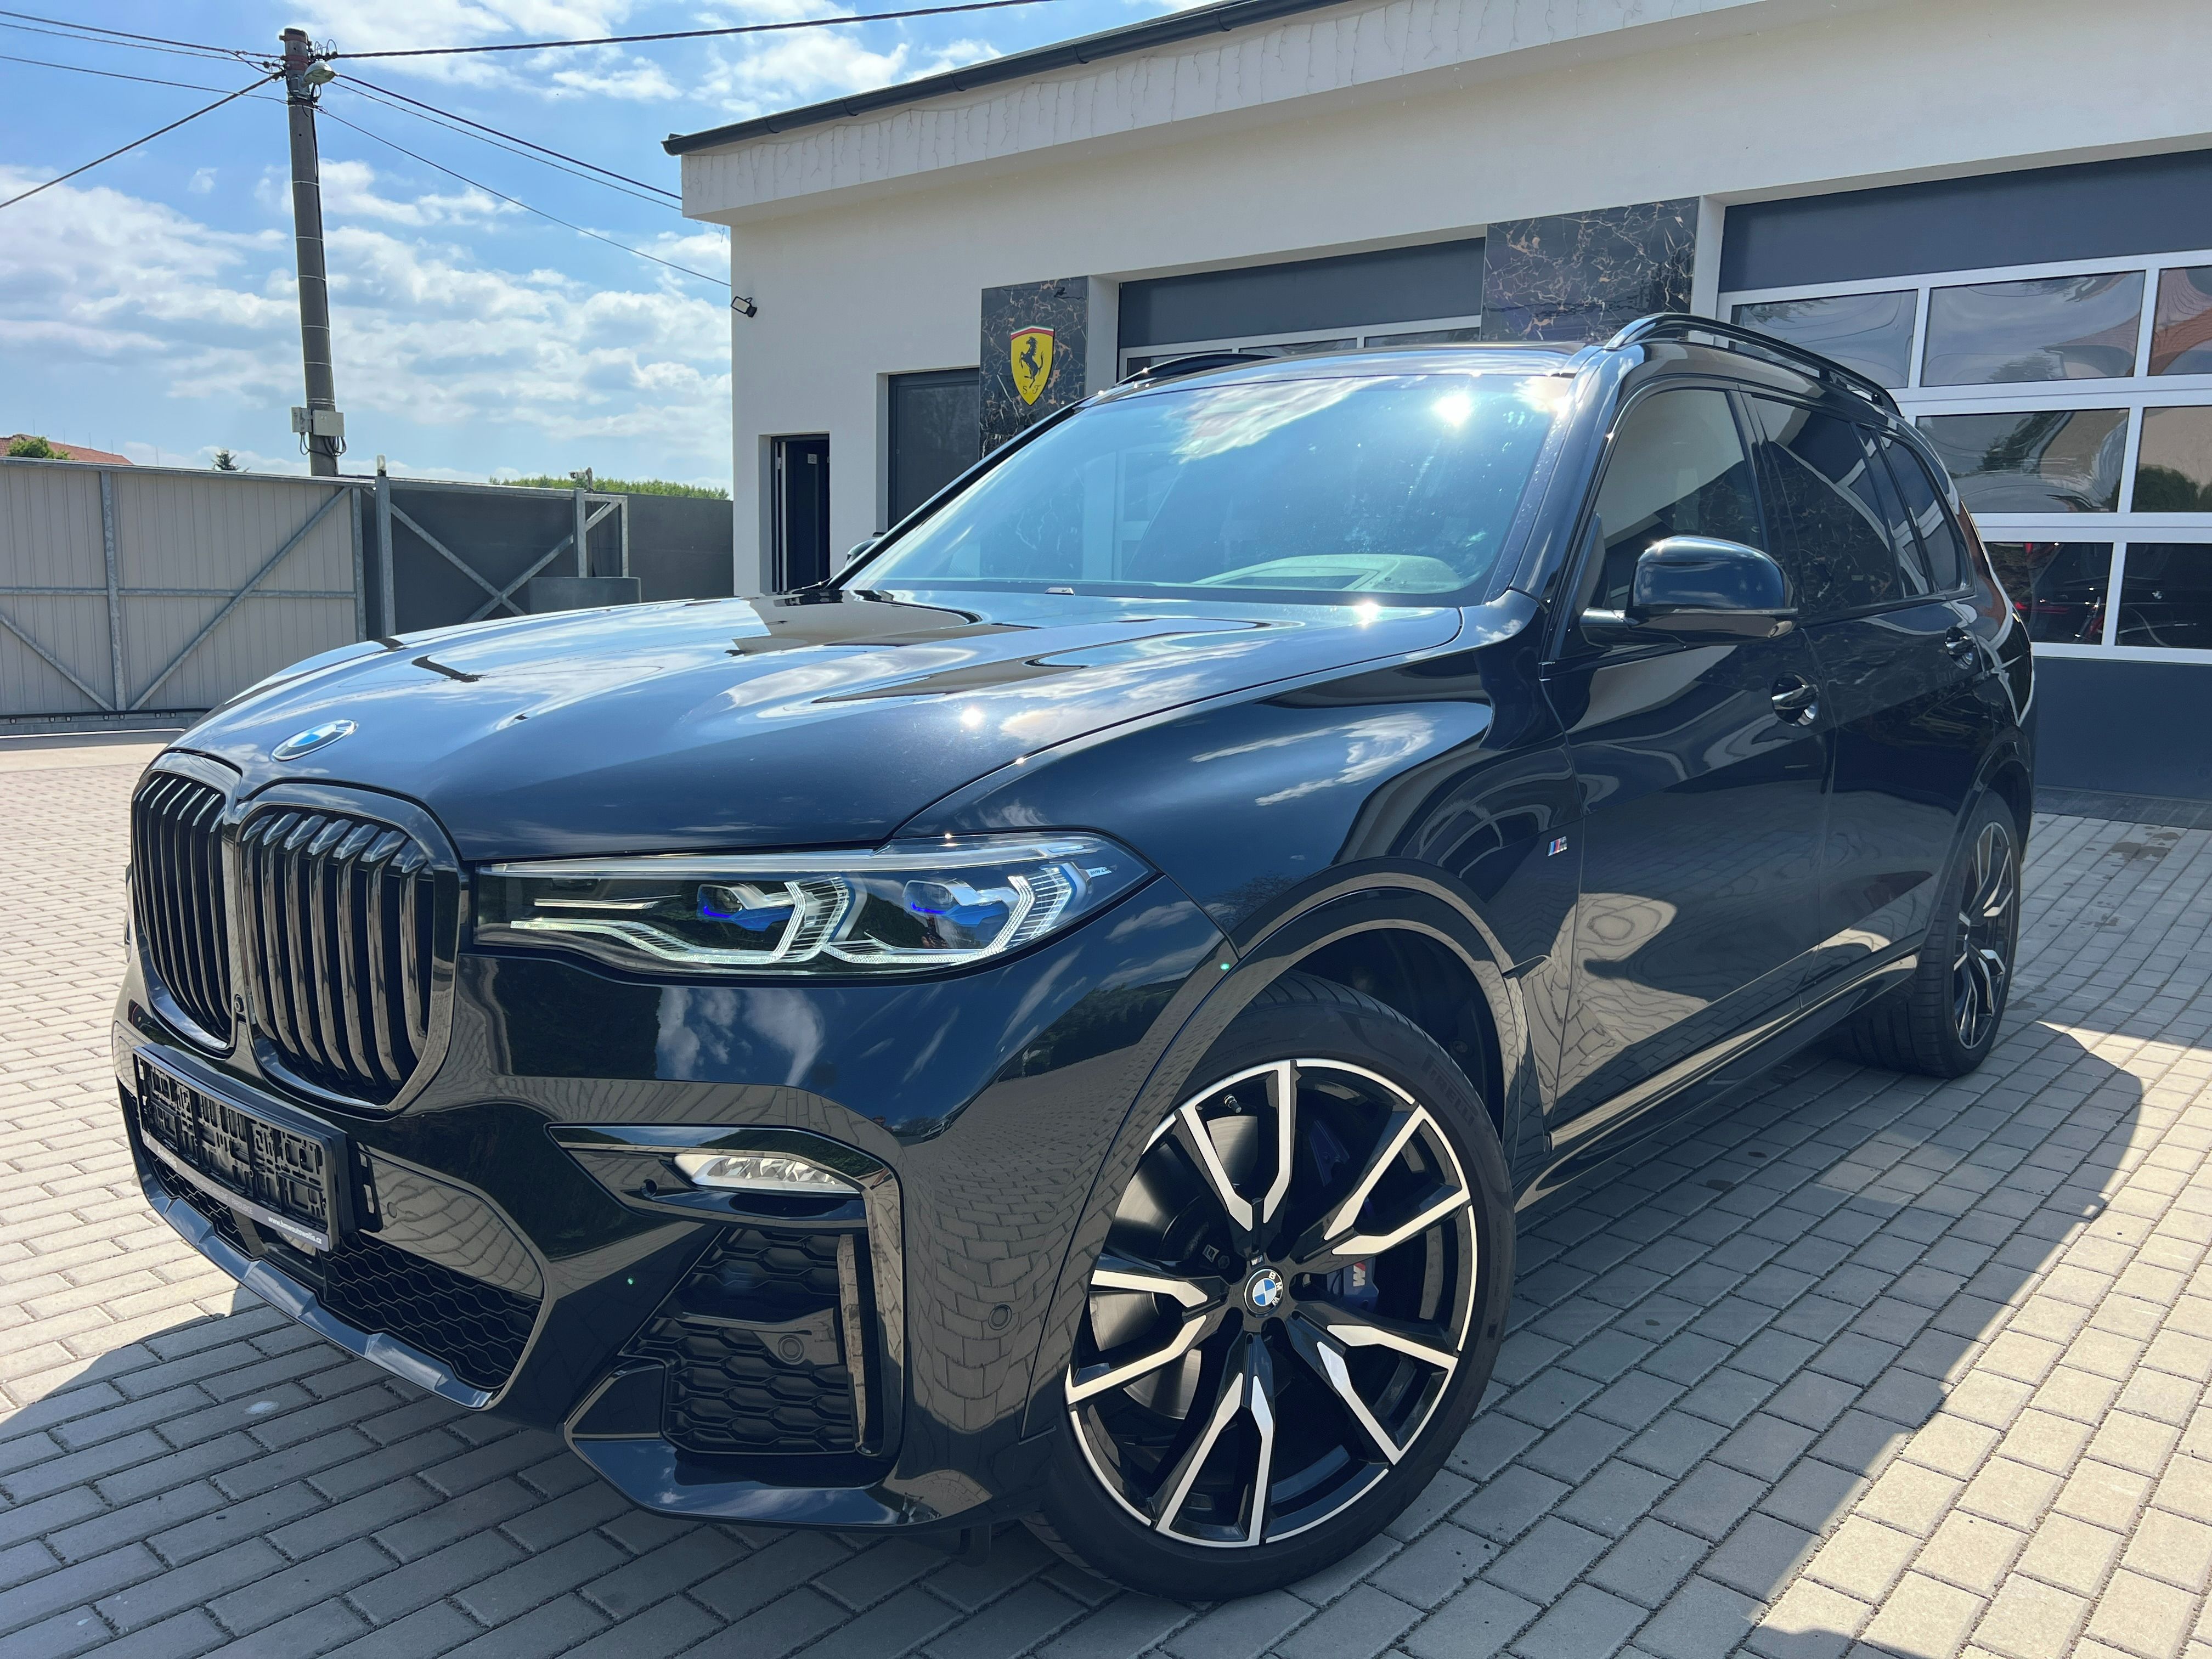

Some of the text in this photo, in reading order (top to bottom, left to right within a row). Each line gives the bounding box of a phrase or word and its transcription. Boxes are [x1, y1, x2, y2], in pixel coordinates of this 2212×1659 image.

[1022, 385, 1042, 395] S F
[1421, 1053, 1479, 1127] PIRELLI
[1268, 1271, 1283, 1307] BMW
